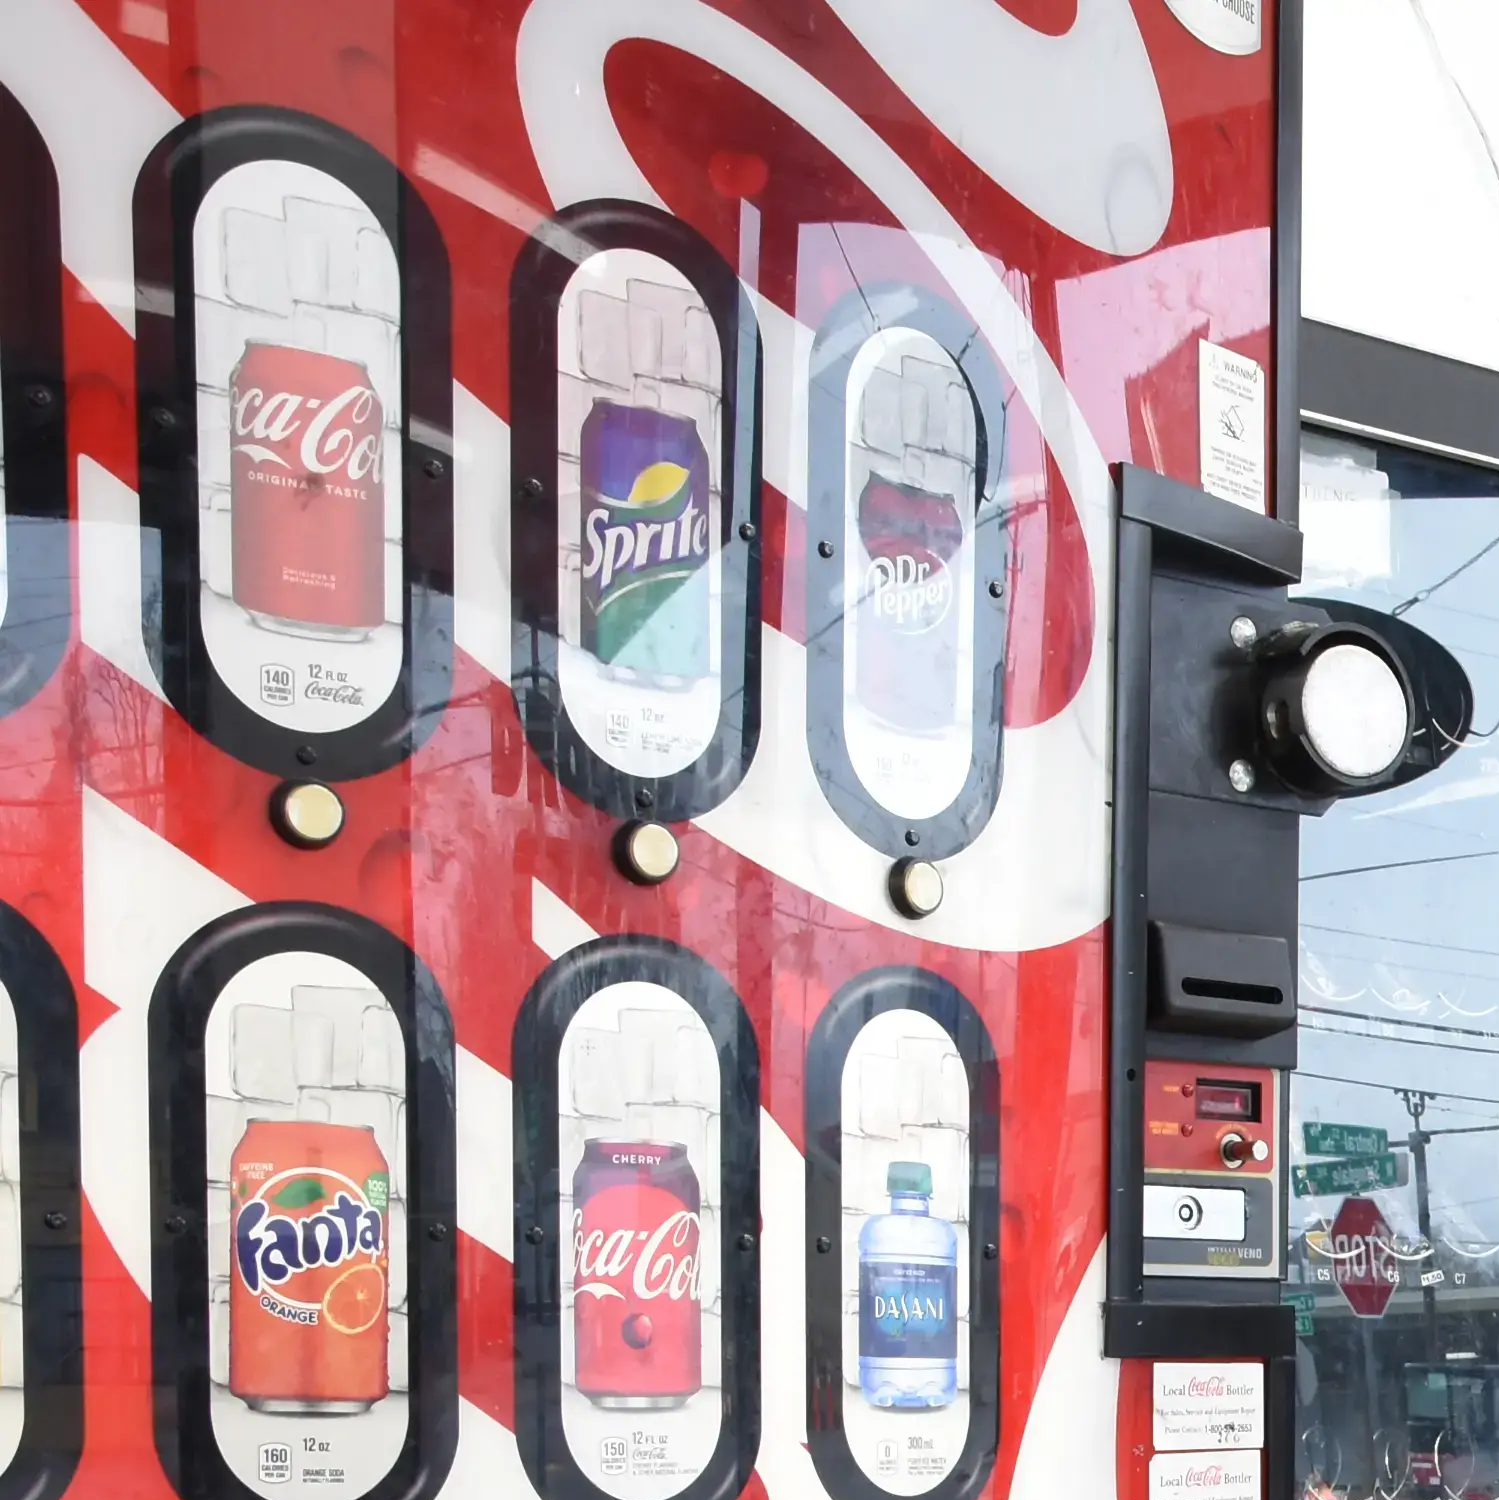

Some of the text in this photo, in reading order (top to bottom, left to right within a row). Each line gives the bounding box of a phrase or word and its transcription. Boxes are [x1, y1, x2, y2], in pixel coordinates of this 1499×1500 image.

[326, 483, 368, 500] TASTE
[582, 493, 707, 590] Sprite
[896, 555, 931, 586] Dr
[872, 556, 948, 624] Pepper
[264, 669, 290, 687] 140
[307, 663, 323, 680] 12
[610, 713, 630, 730] 140
[641, 707, 653, 723] 12
[612, 1154, 662, 1165] CHERRY
[236, 1192, 383, 1294] Fanta
[1237, 1247, 1262, 1259] VEND
[1318, 1269, 1330, 1281] C5
[1388, 1271, 1399, 1283] C6
[1455, 1273, 1466, 1285] C7
[260, 1297, 318, 1324] ORANGE
[875, 1292, 943, 1324] DASANI
[1163, 1385, 1185, 1396] Local
[1226, 1384, 1254, 1395] Bottler
[302, 1437, 330, 1452] 12 oz
[632, 1431, 643, 1444] 12
[907, 1436, 923, 1449] 300
[264, 1448, 288, 1463] 160
[603, 1442, 625, 1456] 150
[302, 1469, 344, 1477] ORANGE SODA
[1160, 1476, 1183, 1487] Local
[1224, 1472, 1252, 1484] Bottler
